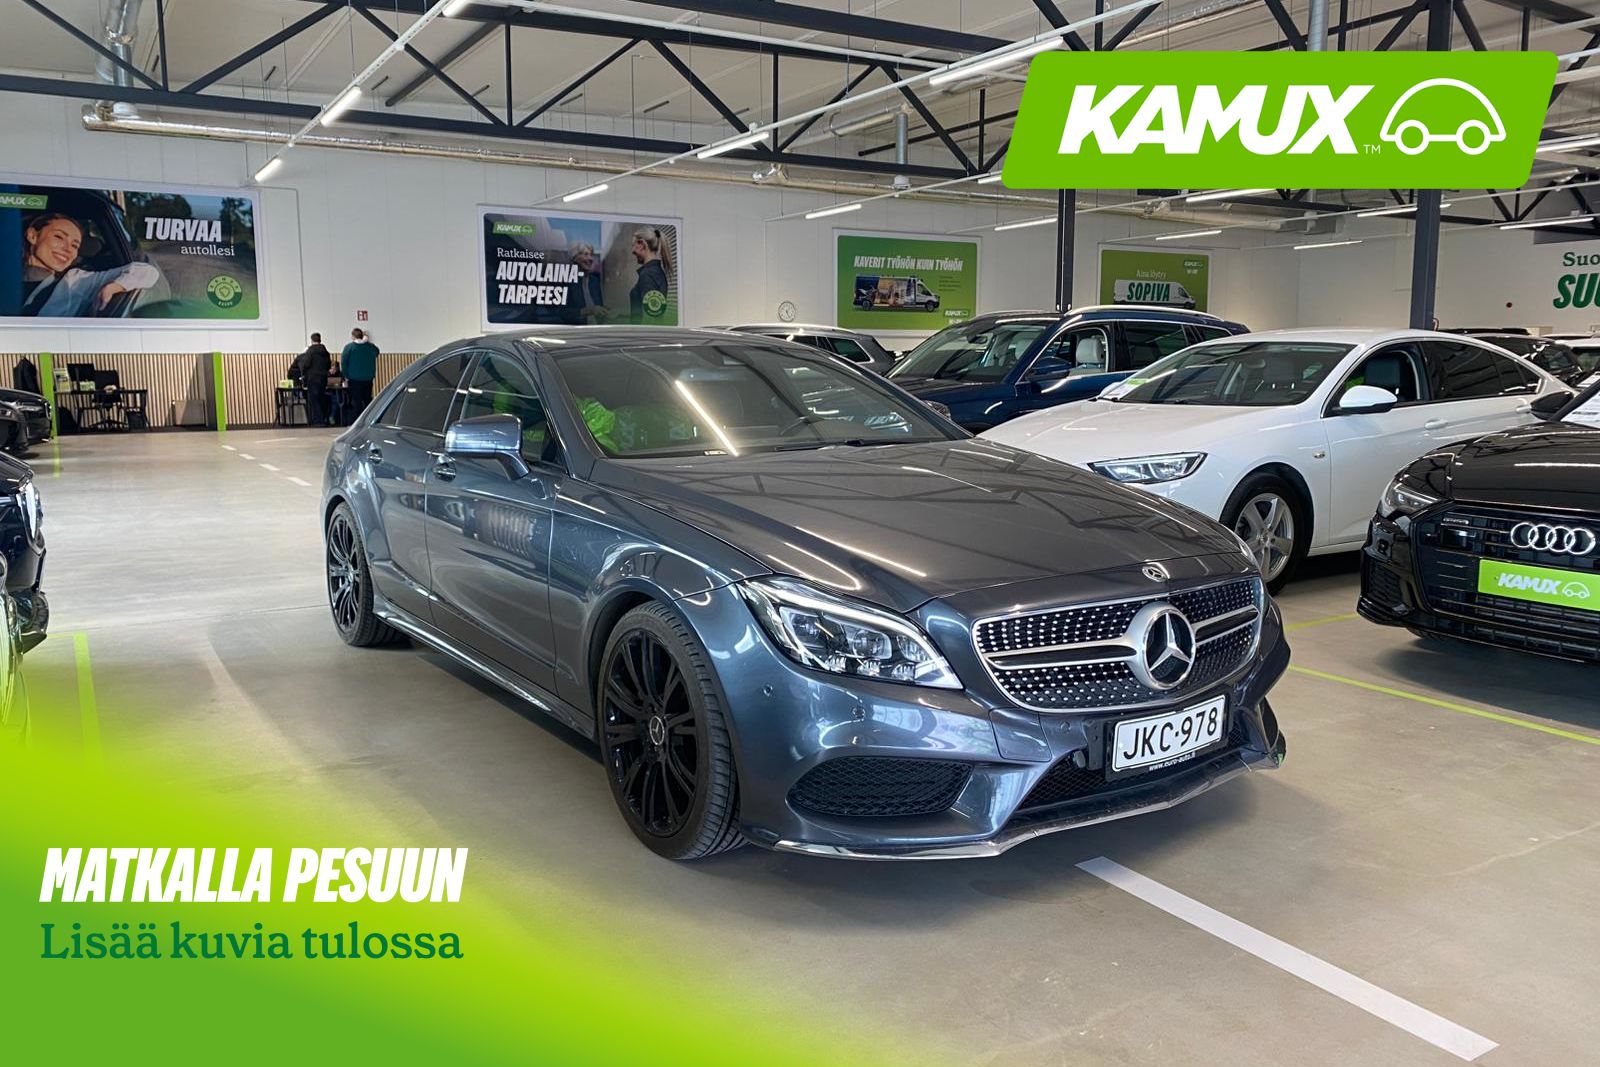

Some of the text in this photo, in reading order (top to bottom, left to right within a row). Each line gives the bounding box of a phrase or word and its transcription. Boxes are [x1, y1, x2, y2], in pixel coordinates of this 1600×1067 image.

[144, 216, 222, 243] TURVAA
[496, 223, 522, 233] KAMUX
[180, 244, 235, 257] autollesi
[496, 247, 545, 260] Ratkaisee
[1562, 252, 1600, 267] Suo
[495, 260, 585, 284] AUTOLAINA-
[854, 255, 964, 272] KAVERIT TYÖHÖN KUIN TYÖHÖN
[498, 284, 568, 306] TARPEESI
[1127, 282, 1171, 302] SOPIVA
[1552, 272, 1600, 309] SU
[1498, 572, 1562, 595] KAMUX
[1123, 706, 1218, 760] JKC-978
